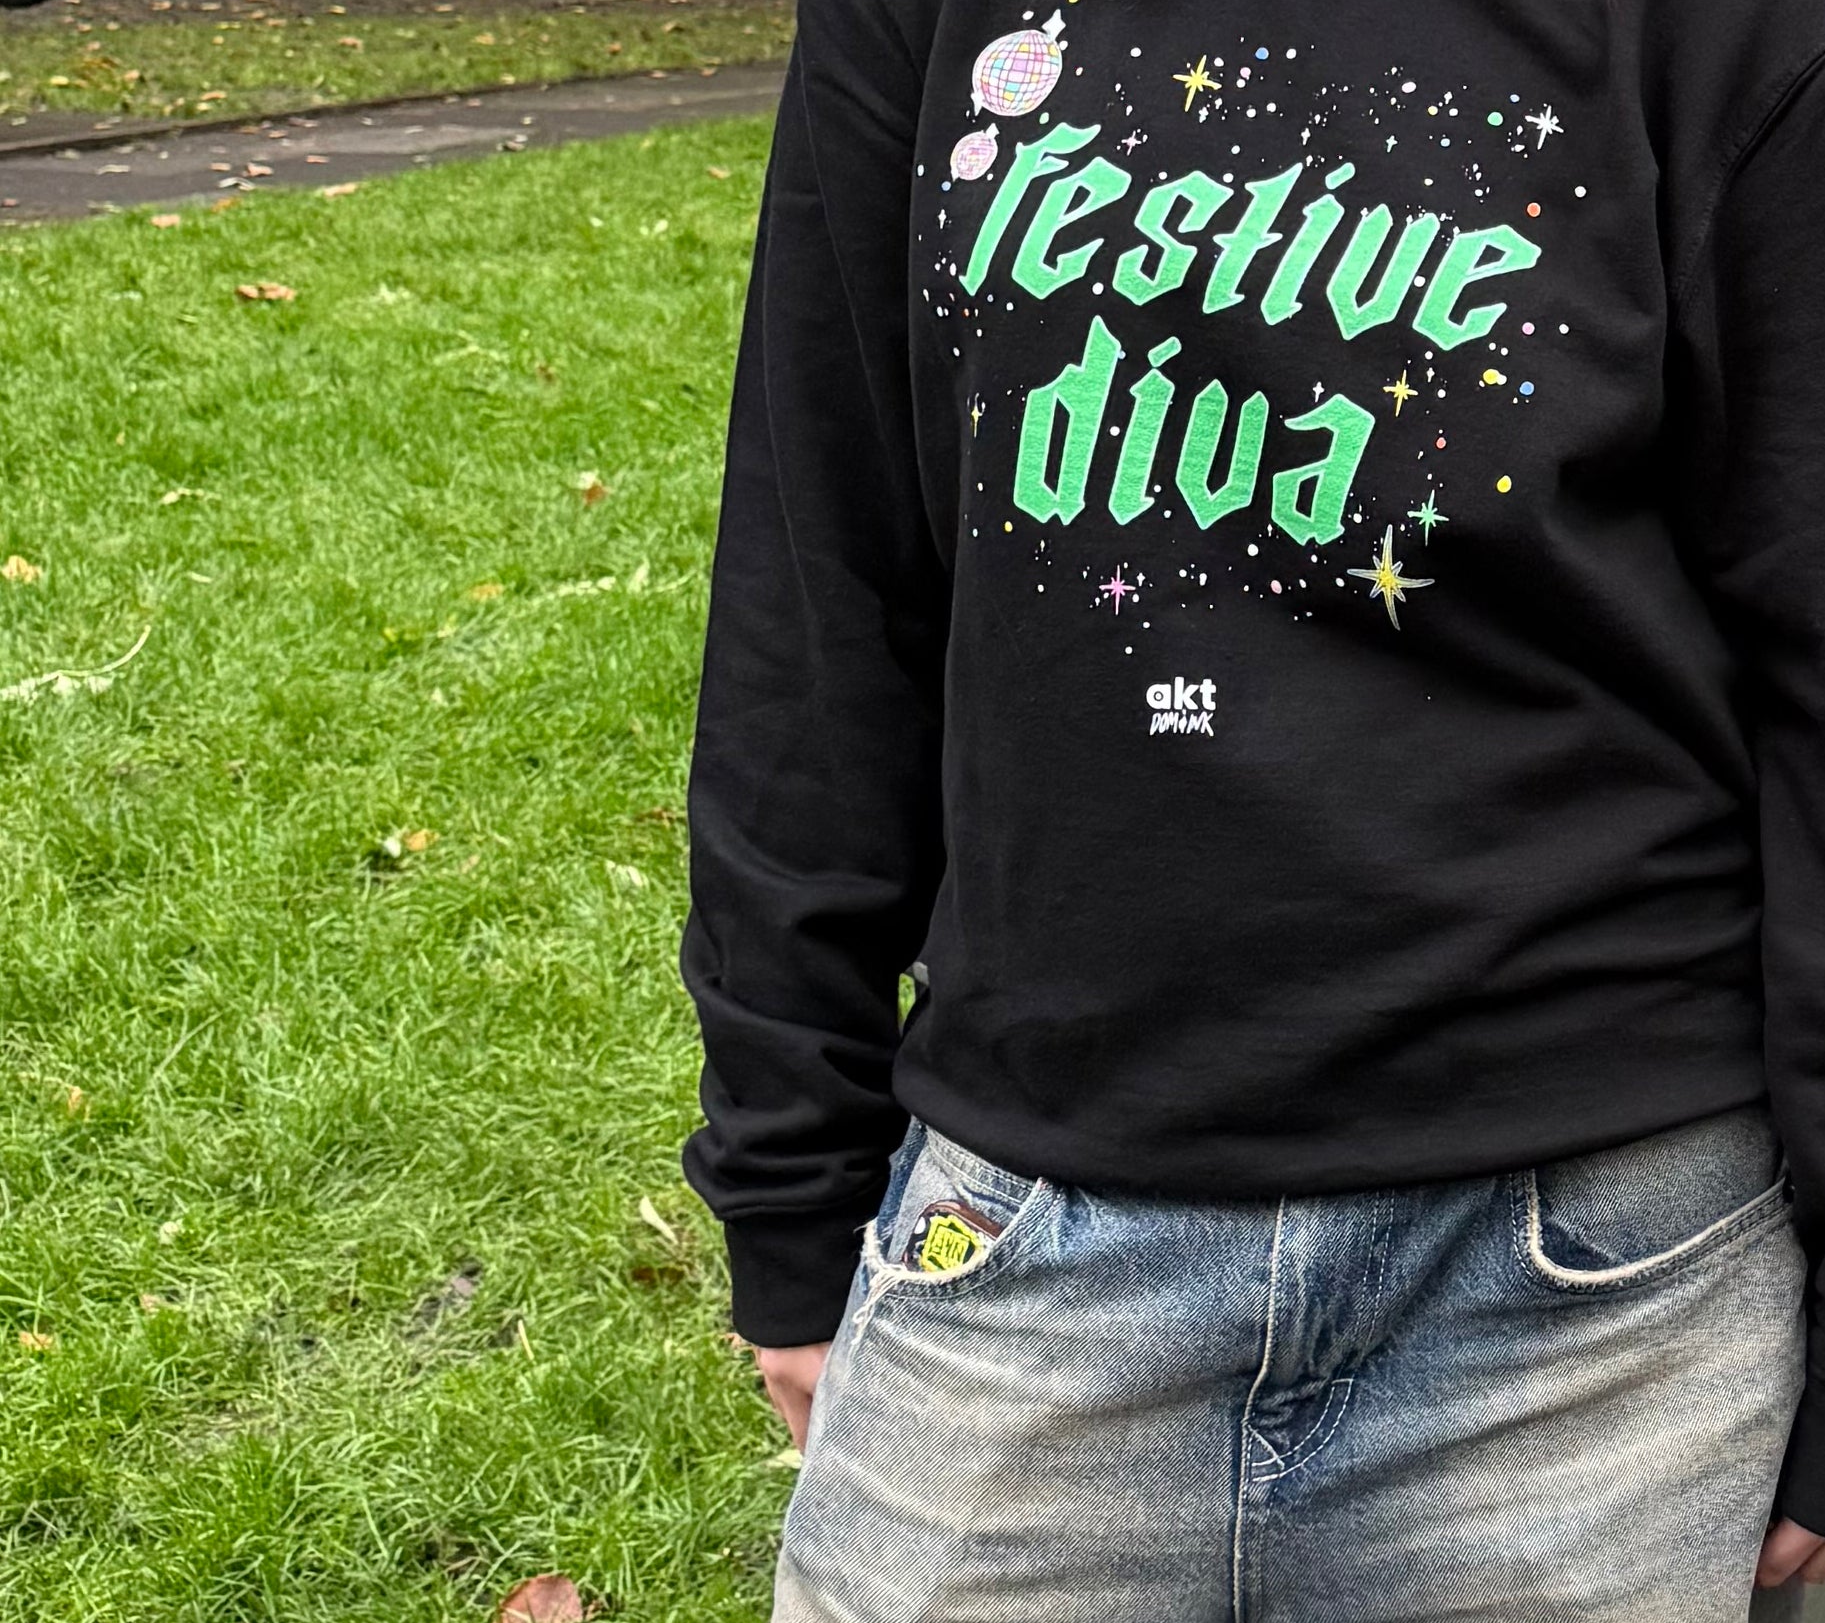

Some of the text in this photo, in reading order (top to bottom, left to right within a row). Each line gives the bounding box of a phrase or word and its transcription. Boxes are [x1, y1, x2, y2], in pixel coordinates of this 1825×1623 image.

[959, 122, 1542, 351] festive
[1013, 315, 1376, 545] diva
[1146, 676, 1217, 711] akt
